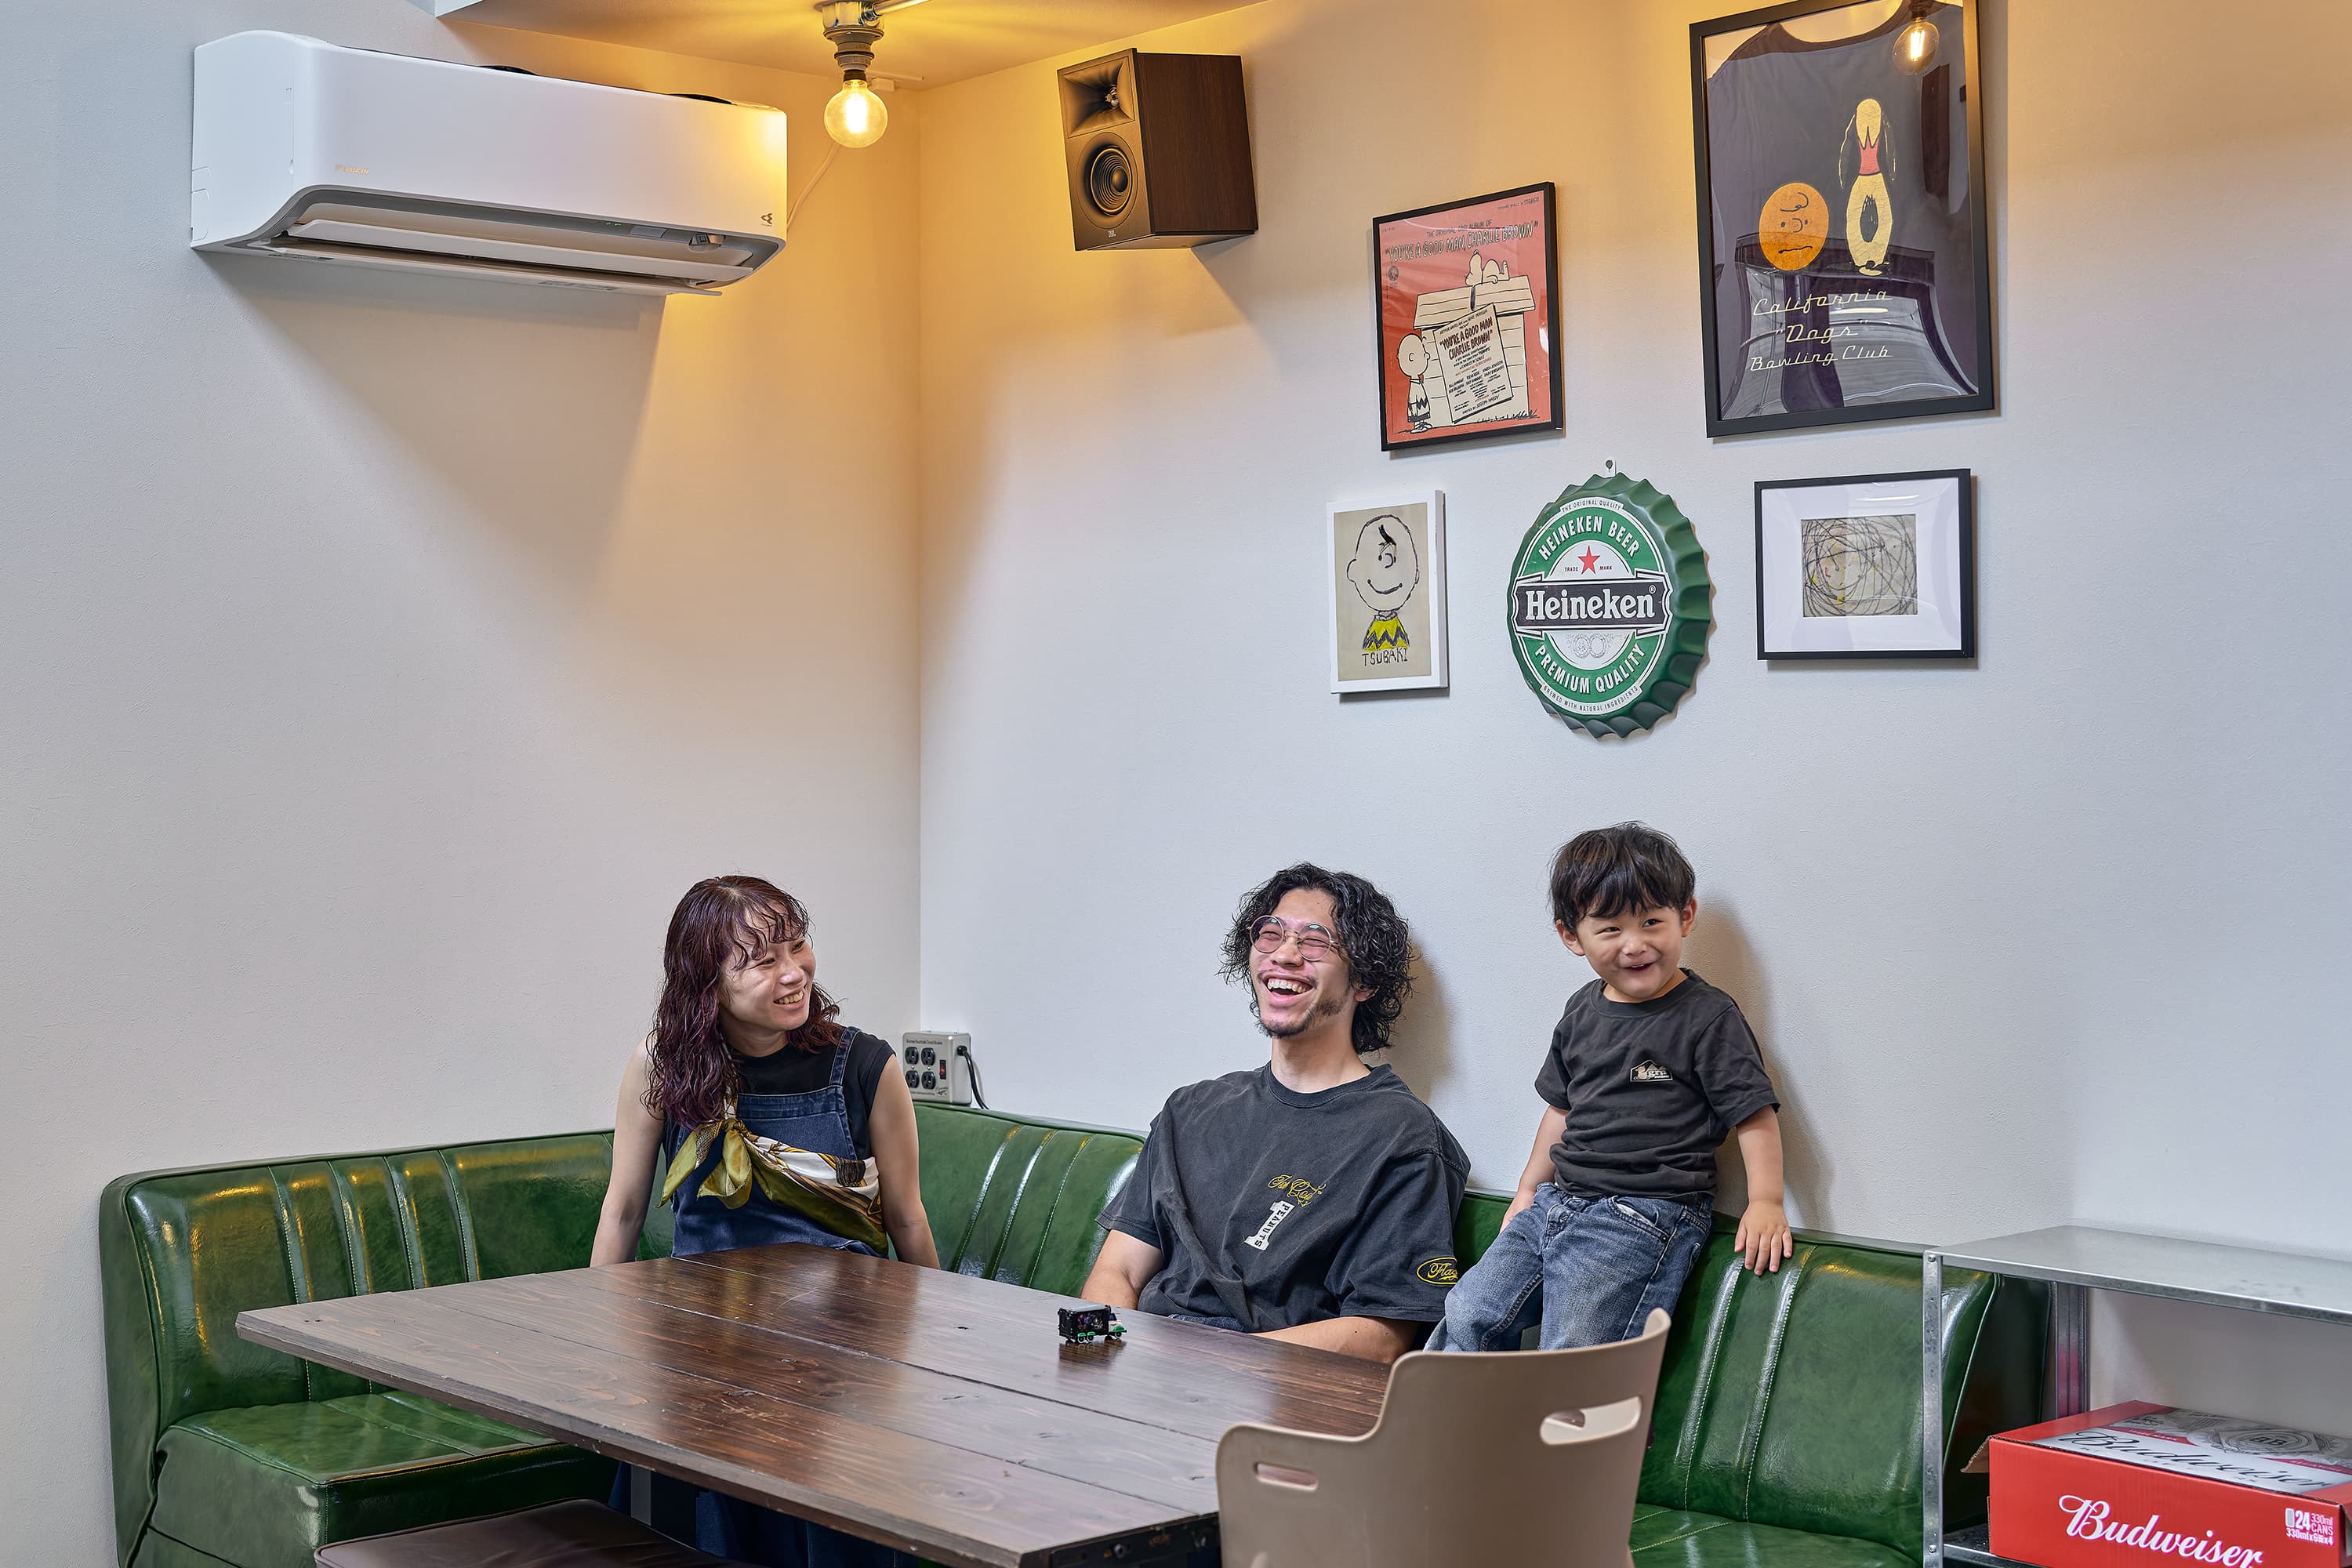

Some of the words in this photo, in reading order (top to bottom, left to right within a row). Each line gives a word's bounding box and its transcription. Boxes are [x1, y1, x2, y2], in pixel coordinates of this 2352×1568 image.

[1436, 227, 1457, 236] ORIGINAL
[1468, 221, 1486, 230] ALBUM
[1415, 244, 1421, 258] A
[1423, 241, 1443, 257] GOOD
[1466, 228, 1501, 249] CHARLIE
[1753, 288, 1893, 315] California
[1460, 330, 1465, 342] A
[1465, 325, 1479, 339] GOOD
[1479, 316, 1493, 332] MAN
[1448, 340, 1471, 360] CHARLIE
[1750, 352, 1838, 372] Bowling
[1842, 345, 1893, 360] Club
[1562, 504, 1572, 514] THE
[1573, 499, 1598, 509] ORIGINAL
[1599, 499, 1622, 510] QUALITY
[1538, 515, 1603, 561] HEINEKEN
[1607, 520, 1640, 557] BEER
[1362, 648, 1408, 666] TSUBAKI
[1534, 644, 1590, 694] PREMIUM
[1595, 643, 1645, 692] QUALITY
[1543, 684, 1563, 704] BREWED
[1563, 700, 1577, 710] WITH
[1605, 685, 1639, 710] INGREDIENTS
[1254, 1203, 1290, 1247] PEANUTS
[2058, 1430, 2334, 1487] Budweiser
[2059, 1494, 2263, 1568] Budweiser
[2295, 1510, 2311, 1530] 24
[2310, 1513, 2333, 1526] 330ml
[2311, 1523, 2334, 1536] CANS
